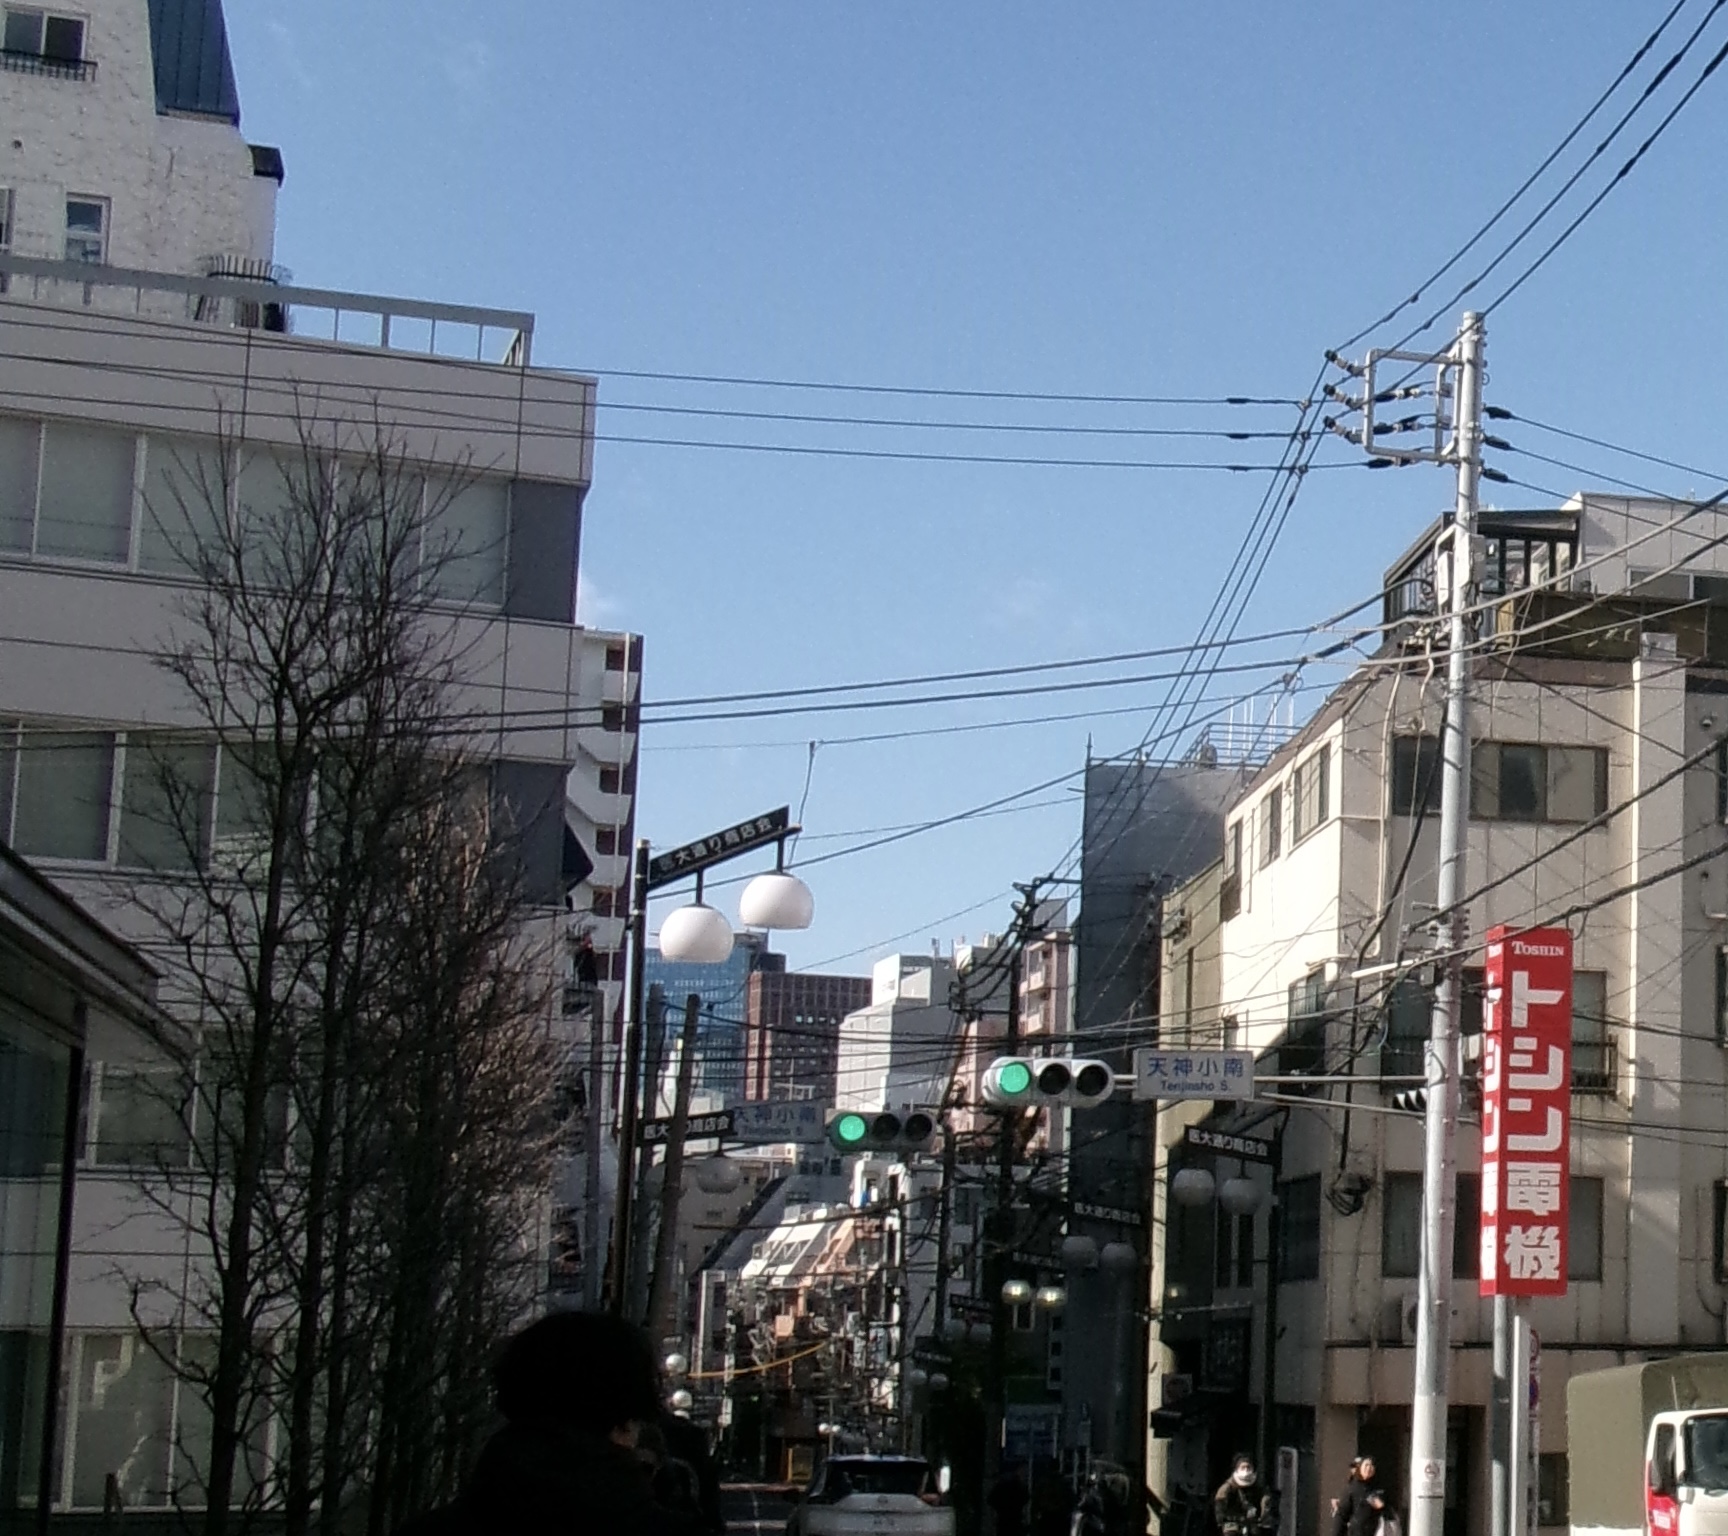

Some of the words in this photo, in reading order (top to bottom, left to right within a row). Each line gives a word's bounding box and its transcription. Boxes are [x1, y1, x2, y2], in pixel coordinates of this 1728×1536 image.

[1511, 939, 1565, 957] TOSHIN
[1146, 1056, 1244, 1078] 天神小南
[1503, 970, 1566, 1280] トシン電機
